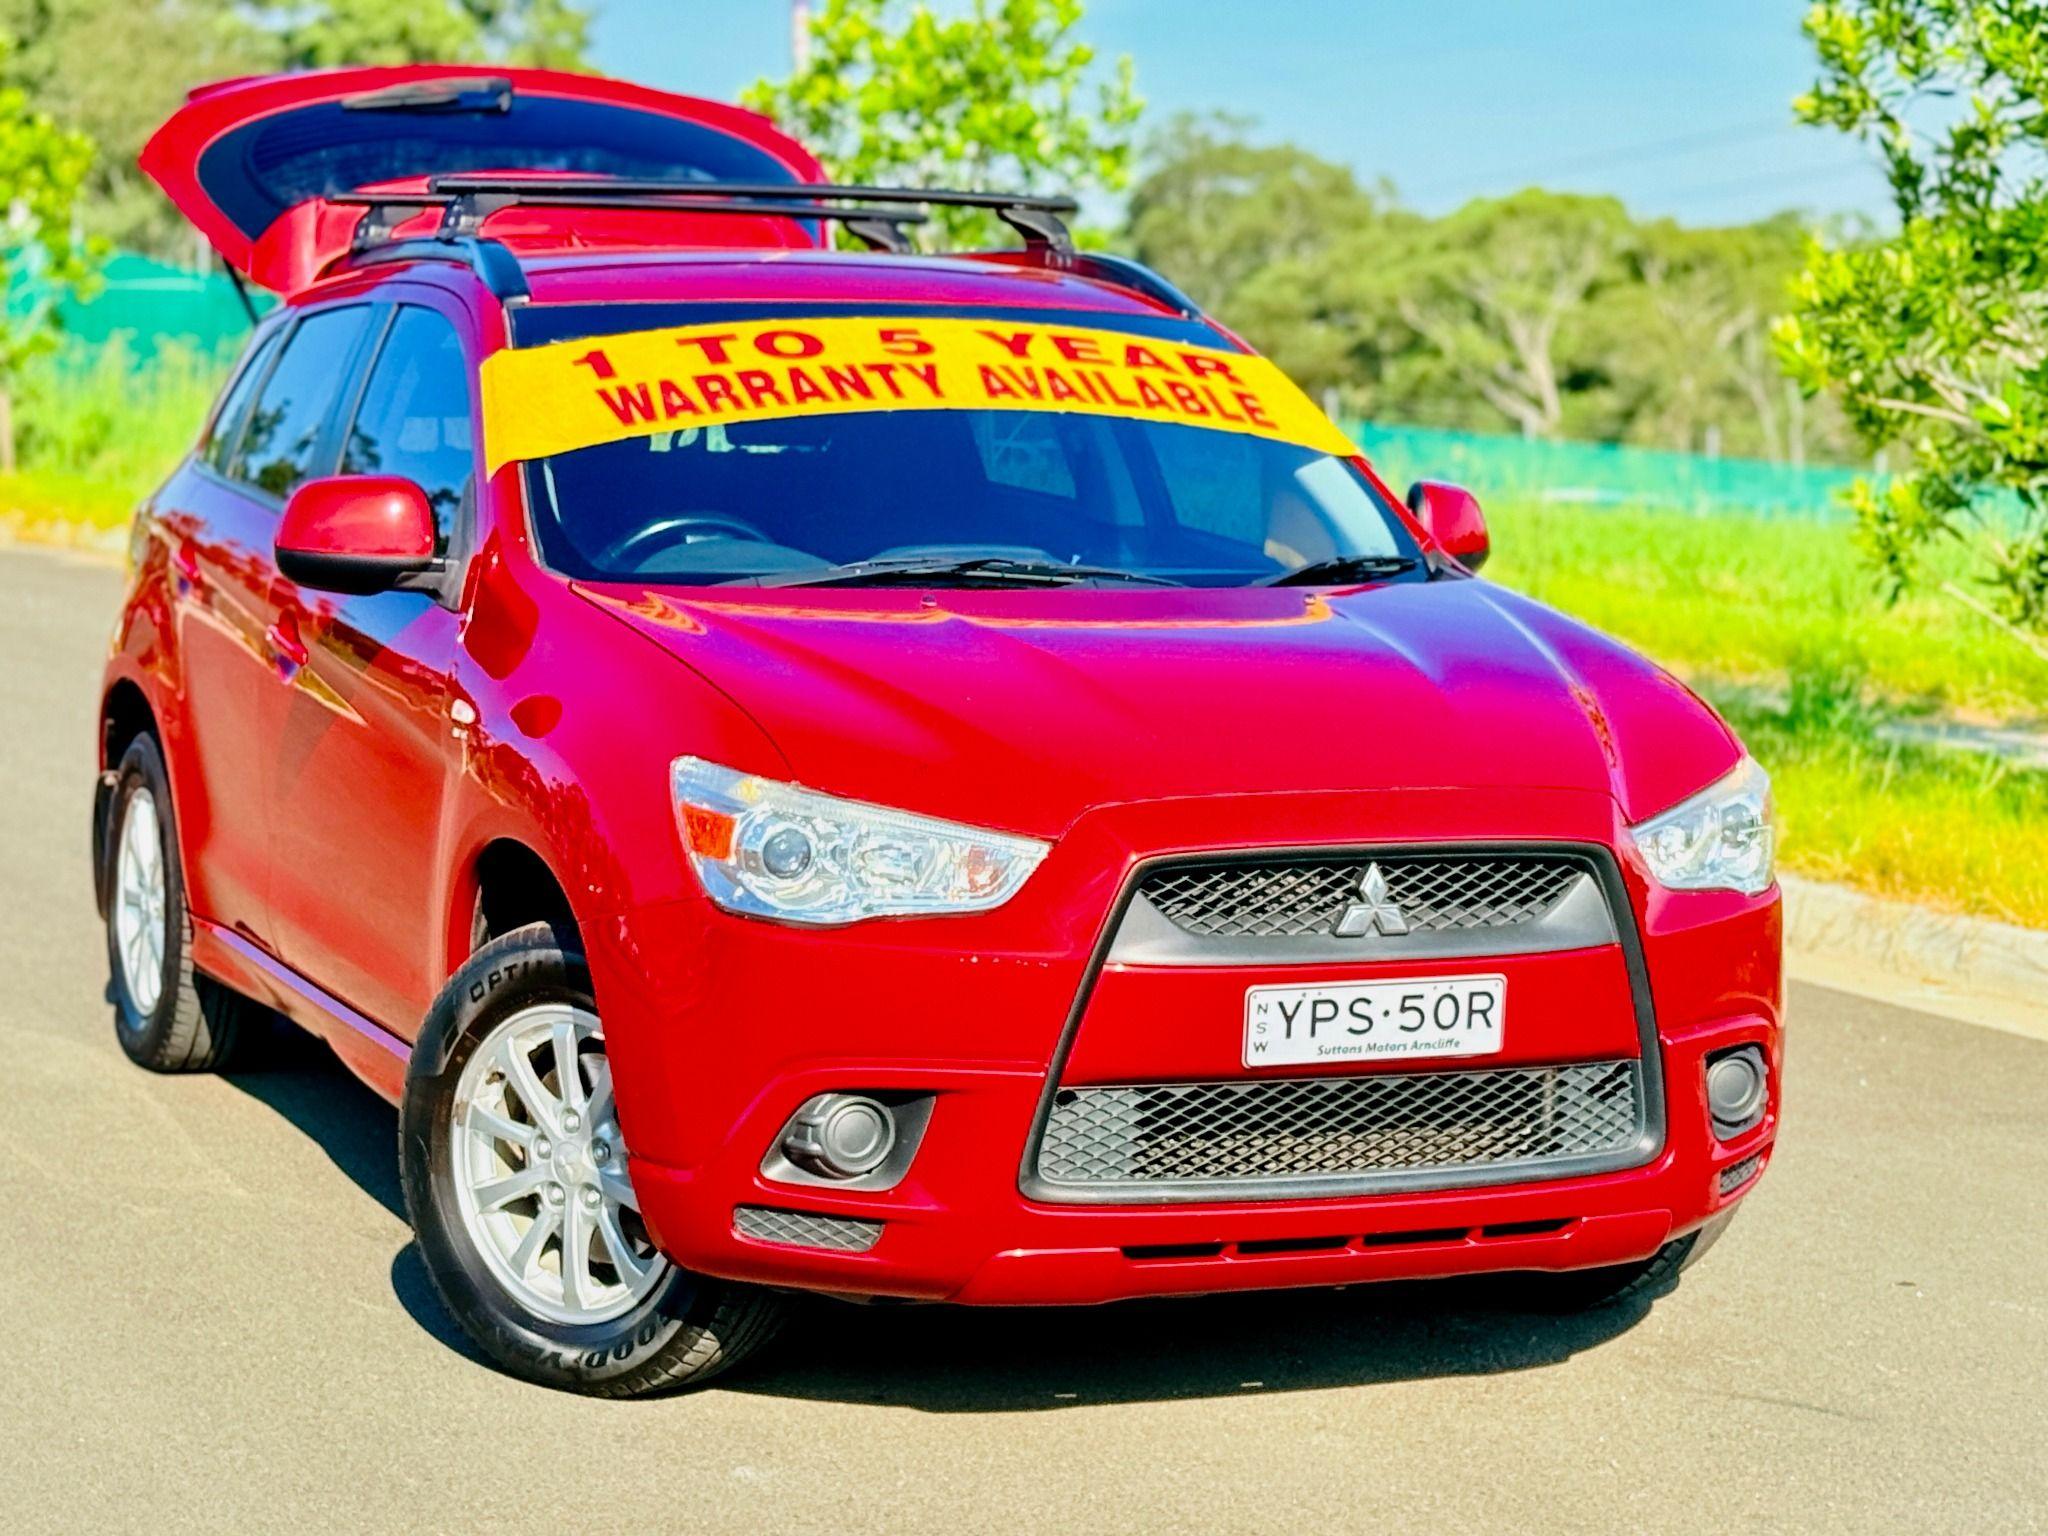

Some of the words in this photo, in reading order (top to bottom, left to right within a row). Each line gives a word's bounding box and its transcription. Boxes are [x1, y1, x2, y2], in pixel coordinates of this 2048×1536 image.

[572, 350, 618, 380] 1
[676, 331, 825, 365] TO
[878, 329, 935, 356] 5
[976, 330, 1245, 385] YEAR
[596, 363, 945, 427] WARRANTY
[978, 364, 1279, 430] AVAILABLE
[1317, 1044, 1362, 1056] Suttons
[1365, 1042, 1408, 1054] Motors
[1410, 1037, 1461, 1051] Arncliffe
